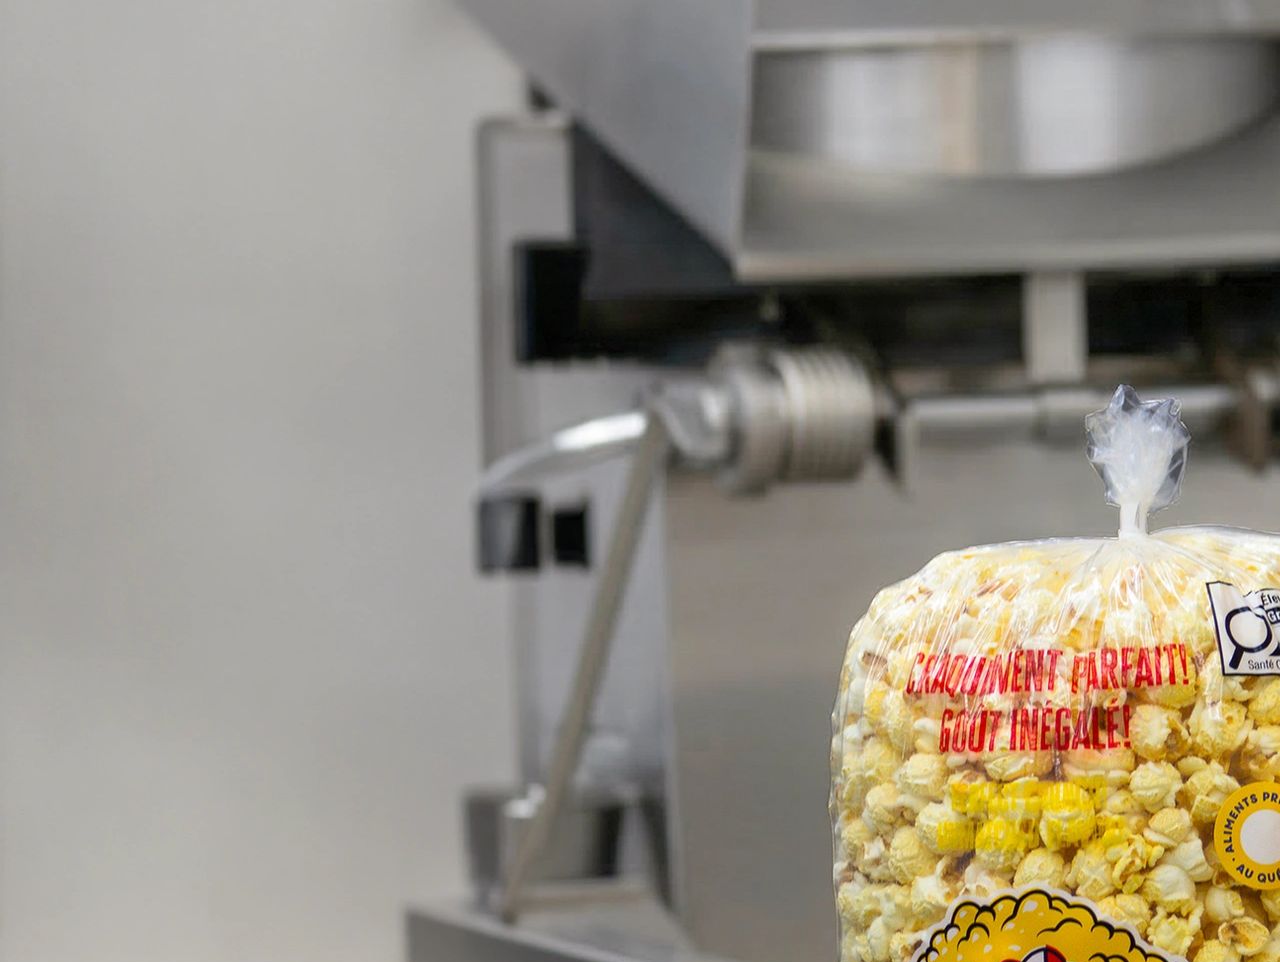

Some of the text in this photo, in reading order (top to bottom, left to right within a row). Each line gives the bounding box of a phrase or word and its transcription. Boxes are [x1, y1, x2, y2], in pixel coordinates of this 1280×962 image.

[1072, 643, 1190, 694] PARFAIT!
[1248, 659, 1274, 670] Santé
[1009, 697, 1132, 751] INÉGALÉ!
[1223, 794, 1258, 853] ALIMENTS
[1236, 863, 1254, 879] AU
